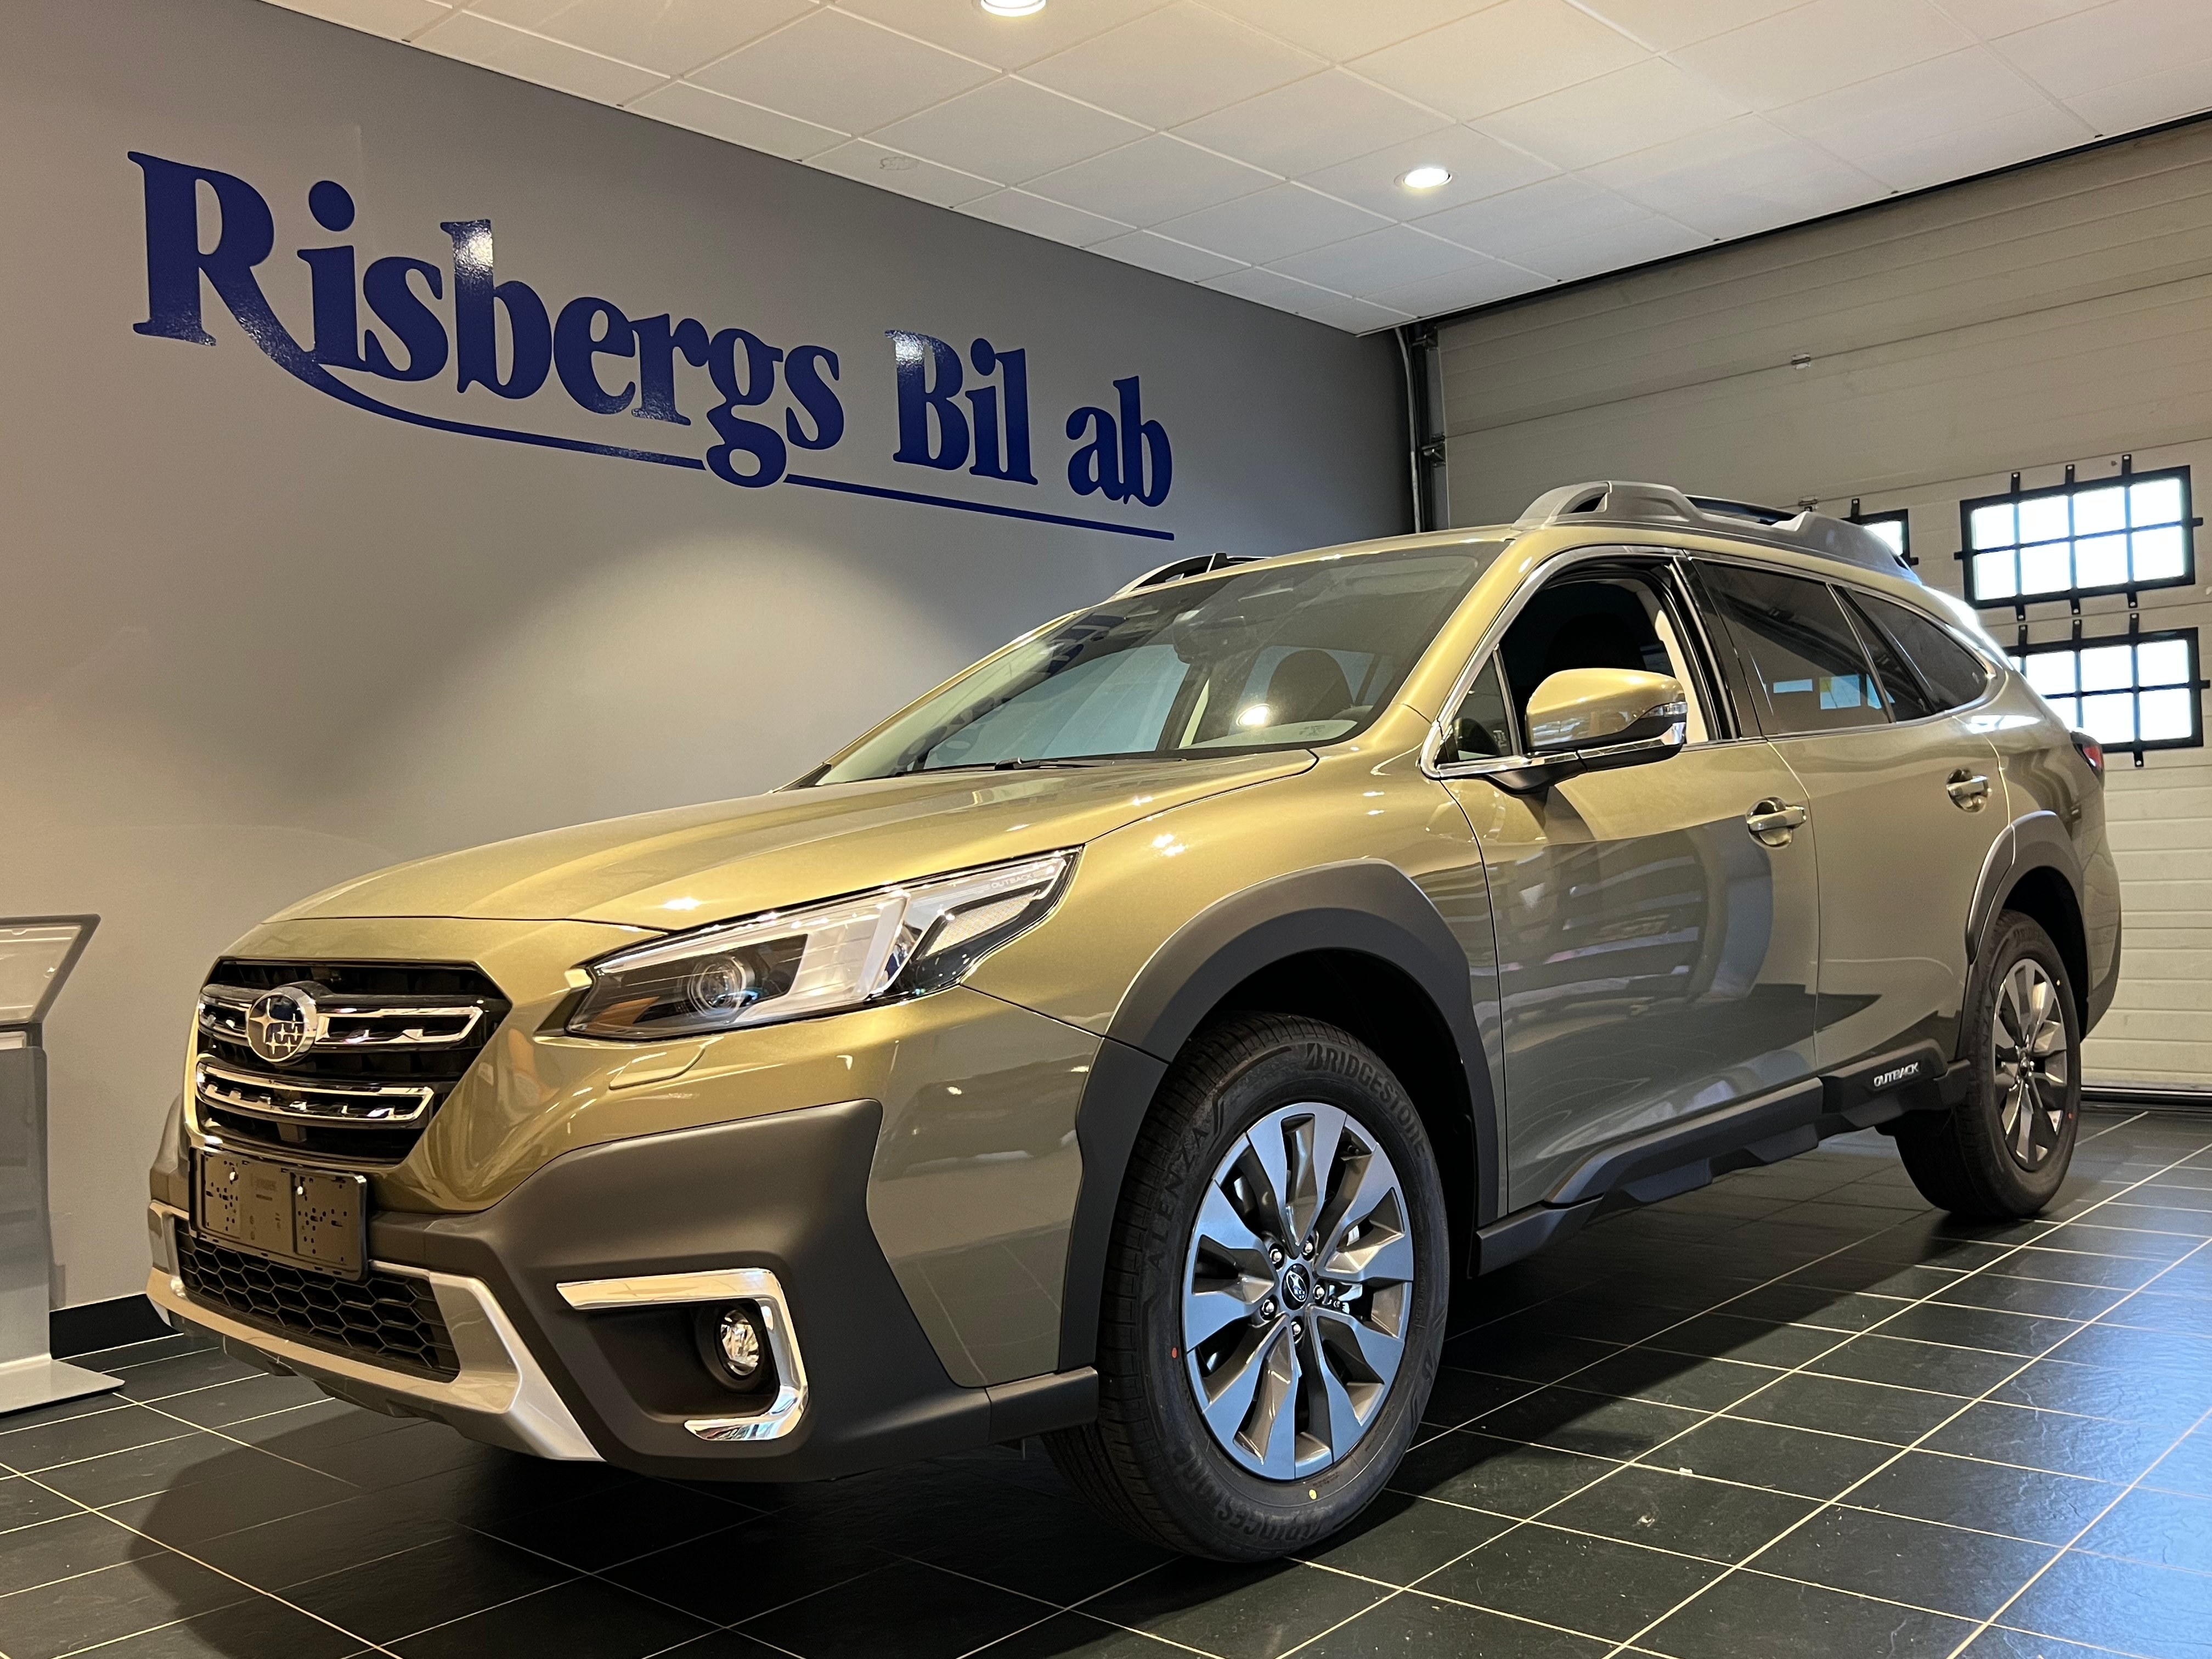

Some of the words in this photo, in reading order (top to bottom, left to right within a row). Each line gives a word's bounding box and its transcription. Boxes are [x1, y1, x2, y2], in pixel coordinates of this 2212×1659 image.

[127, 150, 846, 488] Risbergs
[884, 329, 1039, 487] Bil
[1065, 376, 1174, 509] ab
[991, 873, 1034, 888] OUTBACK
[1304, 1042, 1429, 1160] BRIDGESTONE
[1873, 1062, 1920, 1087] OUTBACK
[1146, 1125, 1210, 1275] ALENZA
